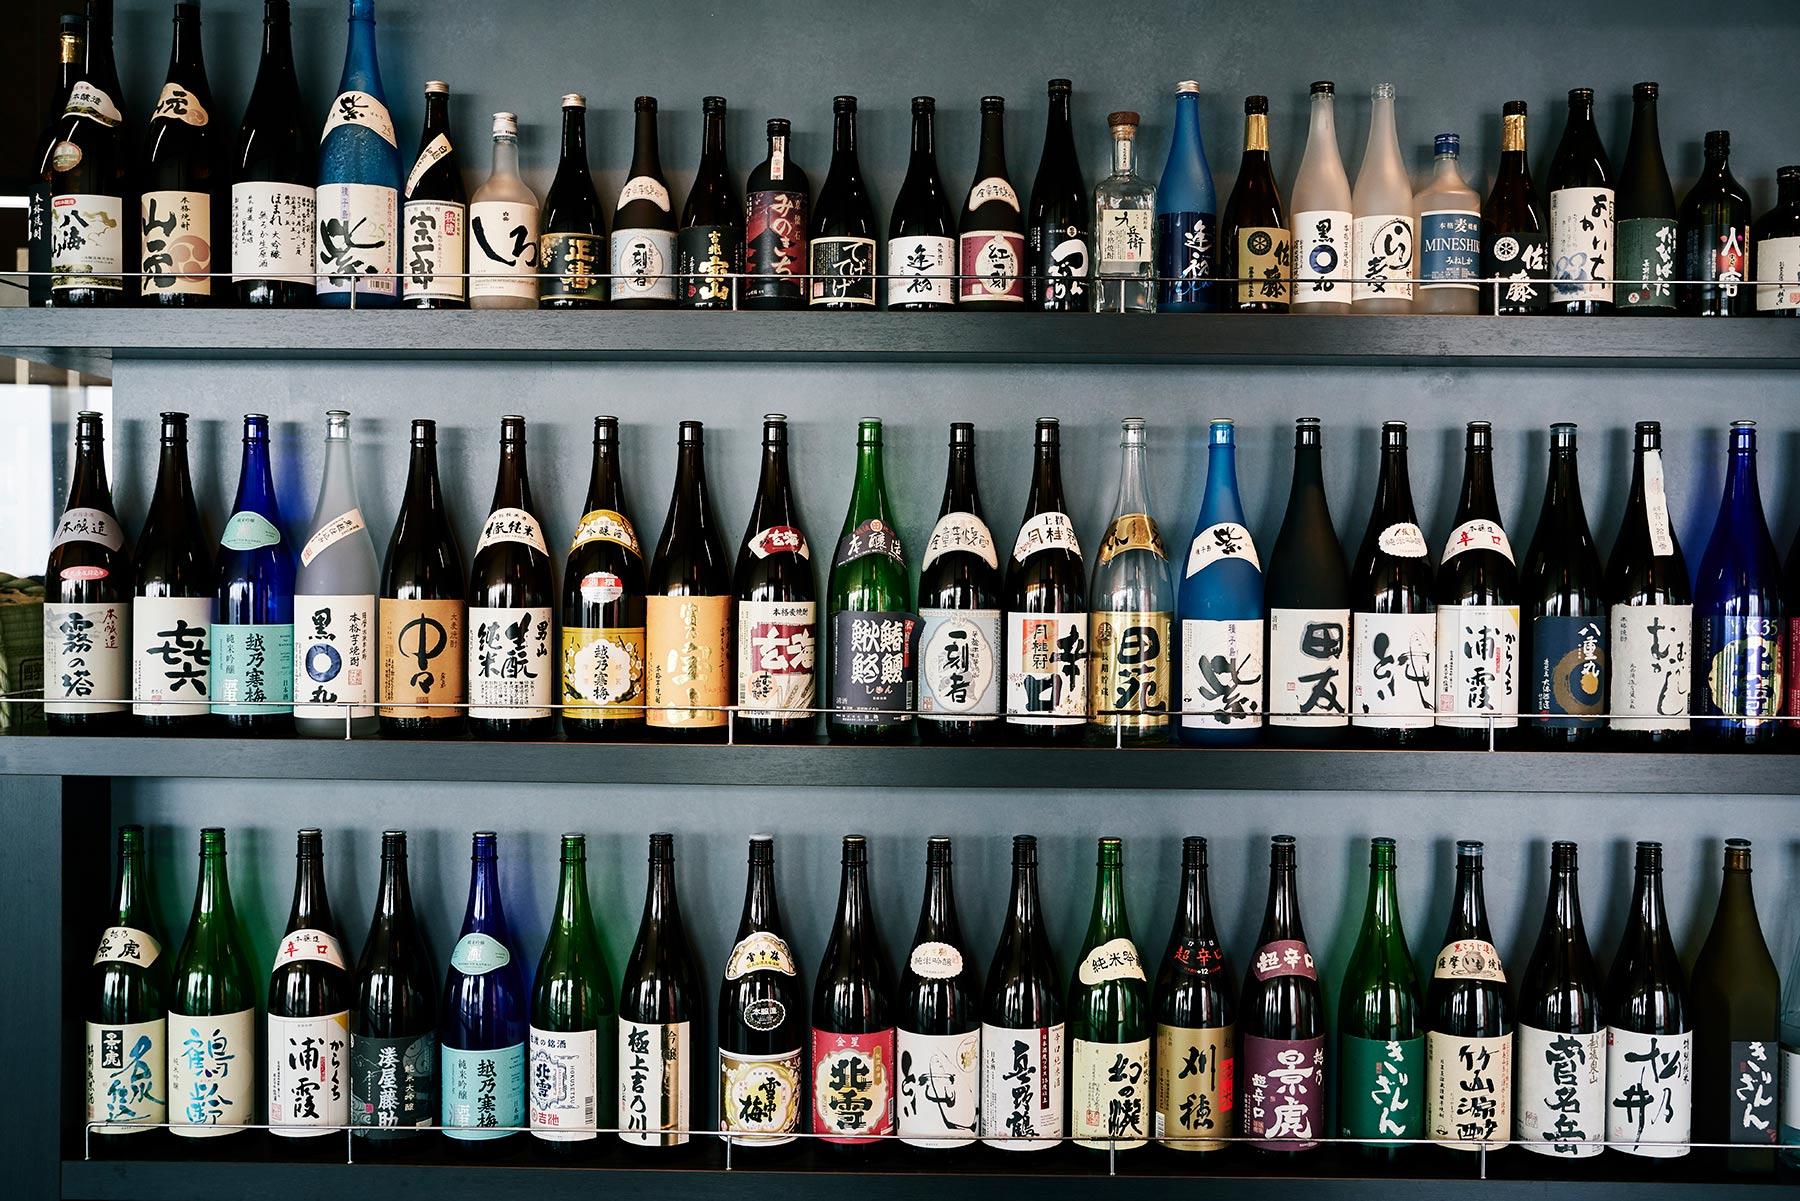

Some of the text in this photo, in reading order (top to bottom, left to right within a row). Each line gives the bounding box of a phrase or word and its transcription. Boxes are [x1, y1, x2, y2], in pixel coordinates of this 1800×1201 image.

[382, 125, 392, 136] 25
[33, 192, 43, 240] 本格焼酎
[271, 193, 282, 226] ほまれ
[369, 223, 385, 238] 25
[410, 211, 436, 290] 宗一郎
[472, 216, 536, 267] しろ
[1115, 211, 1146, 257] 九兵衛
[632, 244, 647, 286] 一刻者
[1260, 240, 1289, 298] 佐藤
[1445, 256, 1473, 265] みねしか
[1505, 243, 1544, 303] 佐藤
[59, 518, 108, 538] 本醸造
[1028, 528, 1076, 547] 月桂冠
[1043, 515, 1064, 526] 上撰
[1457, 531, 1501, 546] 辛口
[848, 532, 901, 555] 本醸造
[103, 608, 119, 649] 本醸造
[773, 607, 809, 617] 本格麦焼酎
[1100, 624, 1111, 641] 麦
[60, 612, 94, 697] 霧の塔
[226, 634, 235, 675] 純米吟醸
[349, 612, 361, 667] 本格芋焼酎
[478, 621, 503, 678] 純米
[536, 621, 548, 658] 男山
[1032, 624, 1049, 669] 月桂冠
[1578, 623, 1601, 678] 八重丸
[245, 634, 267, 703] 越乃寒梅
[593, 645, 610, 700] 越乃寒梅
[943, 630, 969, 704] 一刻者
[1024, 624, 1088, 712] 辛口
[1101, 652, 1109, 697] 長期貯蔵
[1464, 626, 1499, 710] 浦霞
[1505, 632, 1516, 695] からくち
[98, 938, 141, 959] 景虎
[285, 942, 328, 957] 辛口
[914, 957, 951, 966] 純米吟醸
[1258, 947, 1314, 972] 超辛口
[103, 1032, 122, 1067] 景虎
[835, 1036, 859, 1048] 金星
[289, 1038, 324, 1118] 浦霞
[329, 1039, 344, 1101] からくち
[378, 1047, 399, 1132] 湊屋藤助
[458, 1059, 467, 1100] 純米吟醸
[536, 1064, 551, 1097] 北雪
[628, 1026, 649, 1140] 極上吉乃川
[1179, 1044, 1215, 1130] 刈穂
[477, 1060, 498, 1128] 越乃寒梅
[829, 1057, 872, 1129] 北雪
[1252, 1074, 1268, 1118] 超辛口
[1265, 1050, 1314, 1139] 景虎
[1543, 1035, 1586, 1155] 菅名岳
